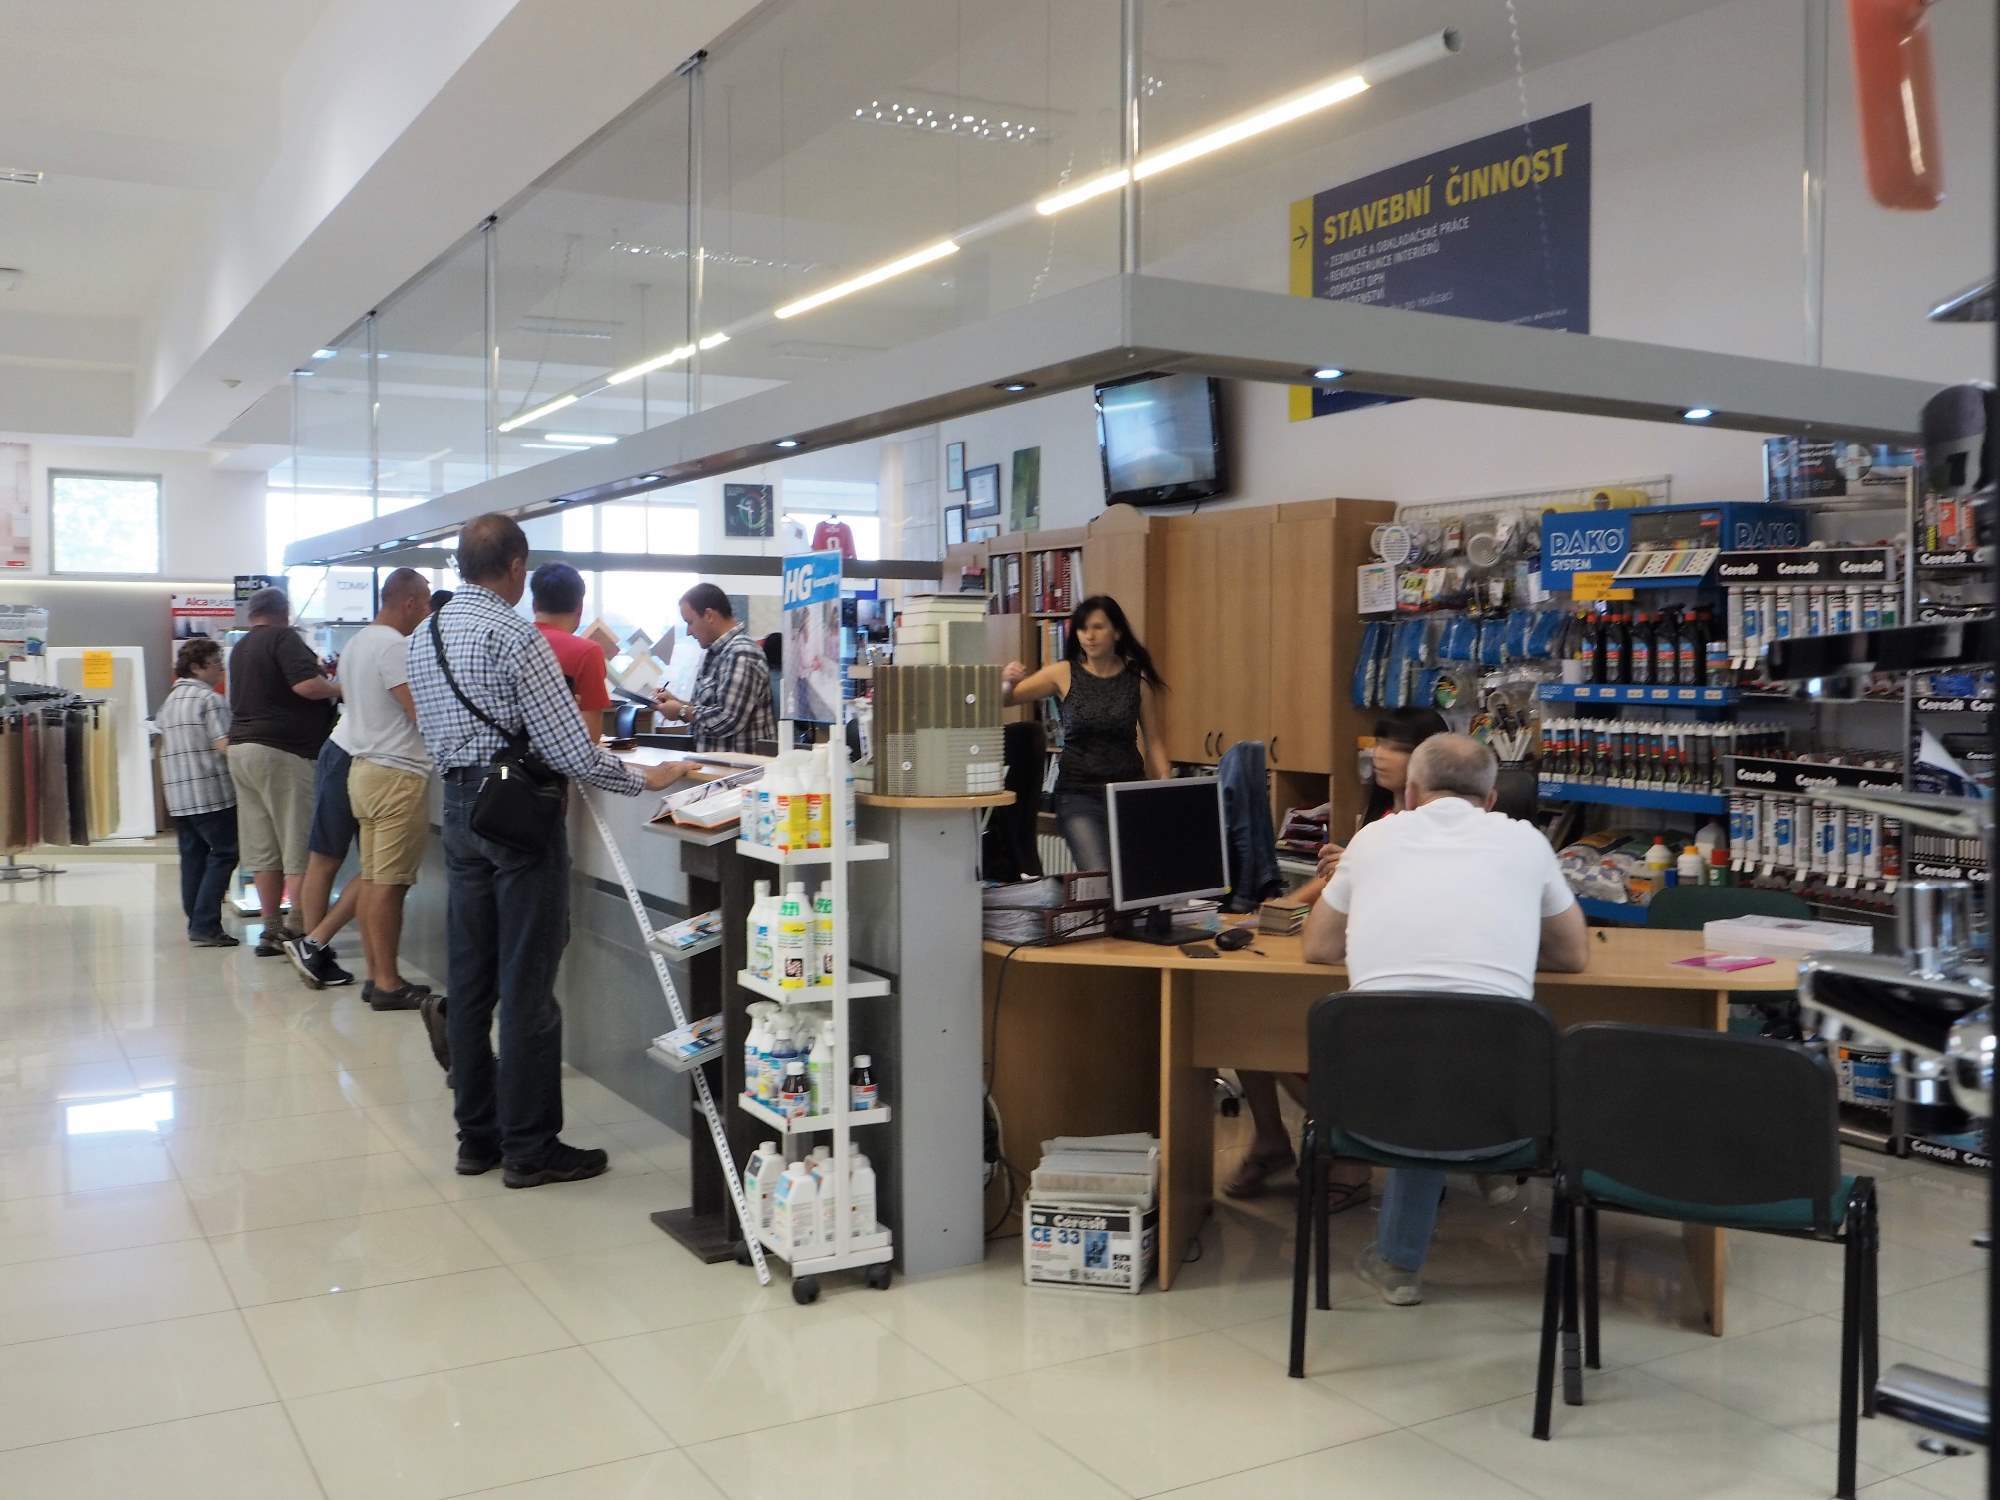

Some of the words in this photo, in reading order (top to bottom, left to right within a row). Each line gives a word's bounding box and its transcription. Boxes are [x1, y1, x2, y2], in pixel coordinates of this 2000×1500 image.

[1323, 174, 1433, 246] STAVEBNÍ
[1444, 143, 1569, 207] ČINNOST
[1438, 216, 1471, 236] PRÁCE
[1550, 528, 1625, 556] RAKO
[1550, 558, 1592, 571] SYSTEM
[784, 563, 813, 604] HG
[1053, 1214, 1108, 1230] Ceresit
[1031, 1226, 1052, 1242] CE
[1058, 1228, 1080, 1245] 33
